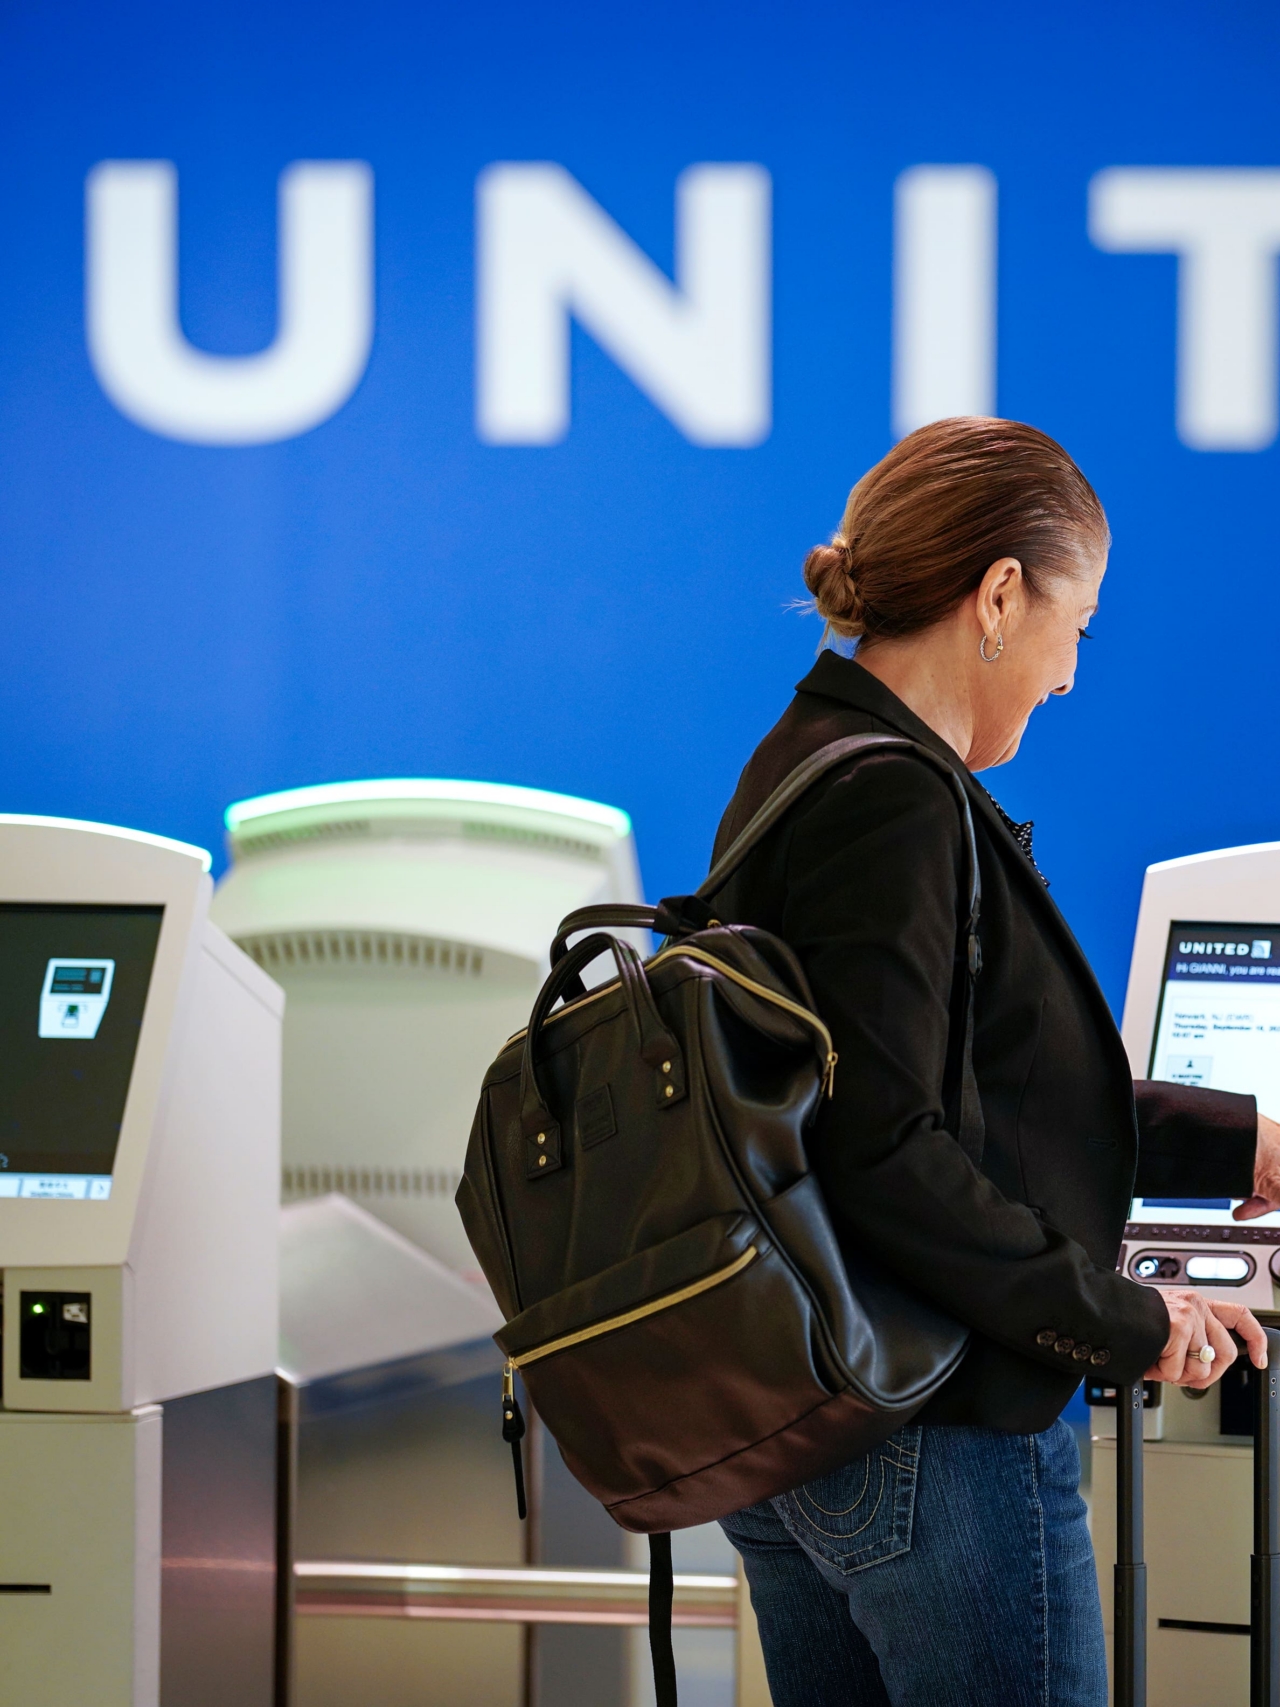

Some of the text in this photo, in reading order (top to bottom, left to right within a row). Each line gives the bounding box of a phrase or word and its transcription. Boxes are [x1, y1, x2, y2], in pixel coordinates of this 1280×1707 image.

[1178, 941, 1250, 956] UNITED
[1176, 962, 1188, 973] Hi
[1229, 965, 1248, 977] you
[1249, 966, 1264, 976] are
